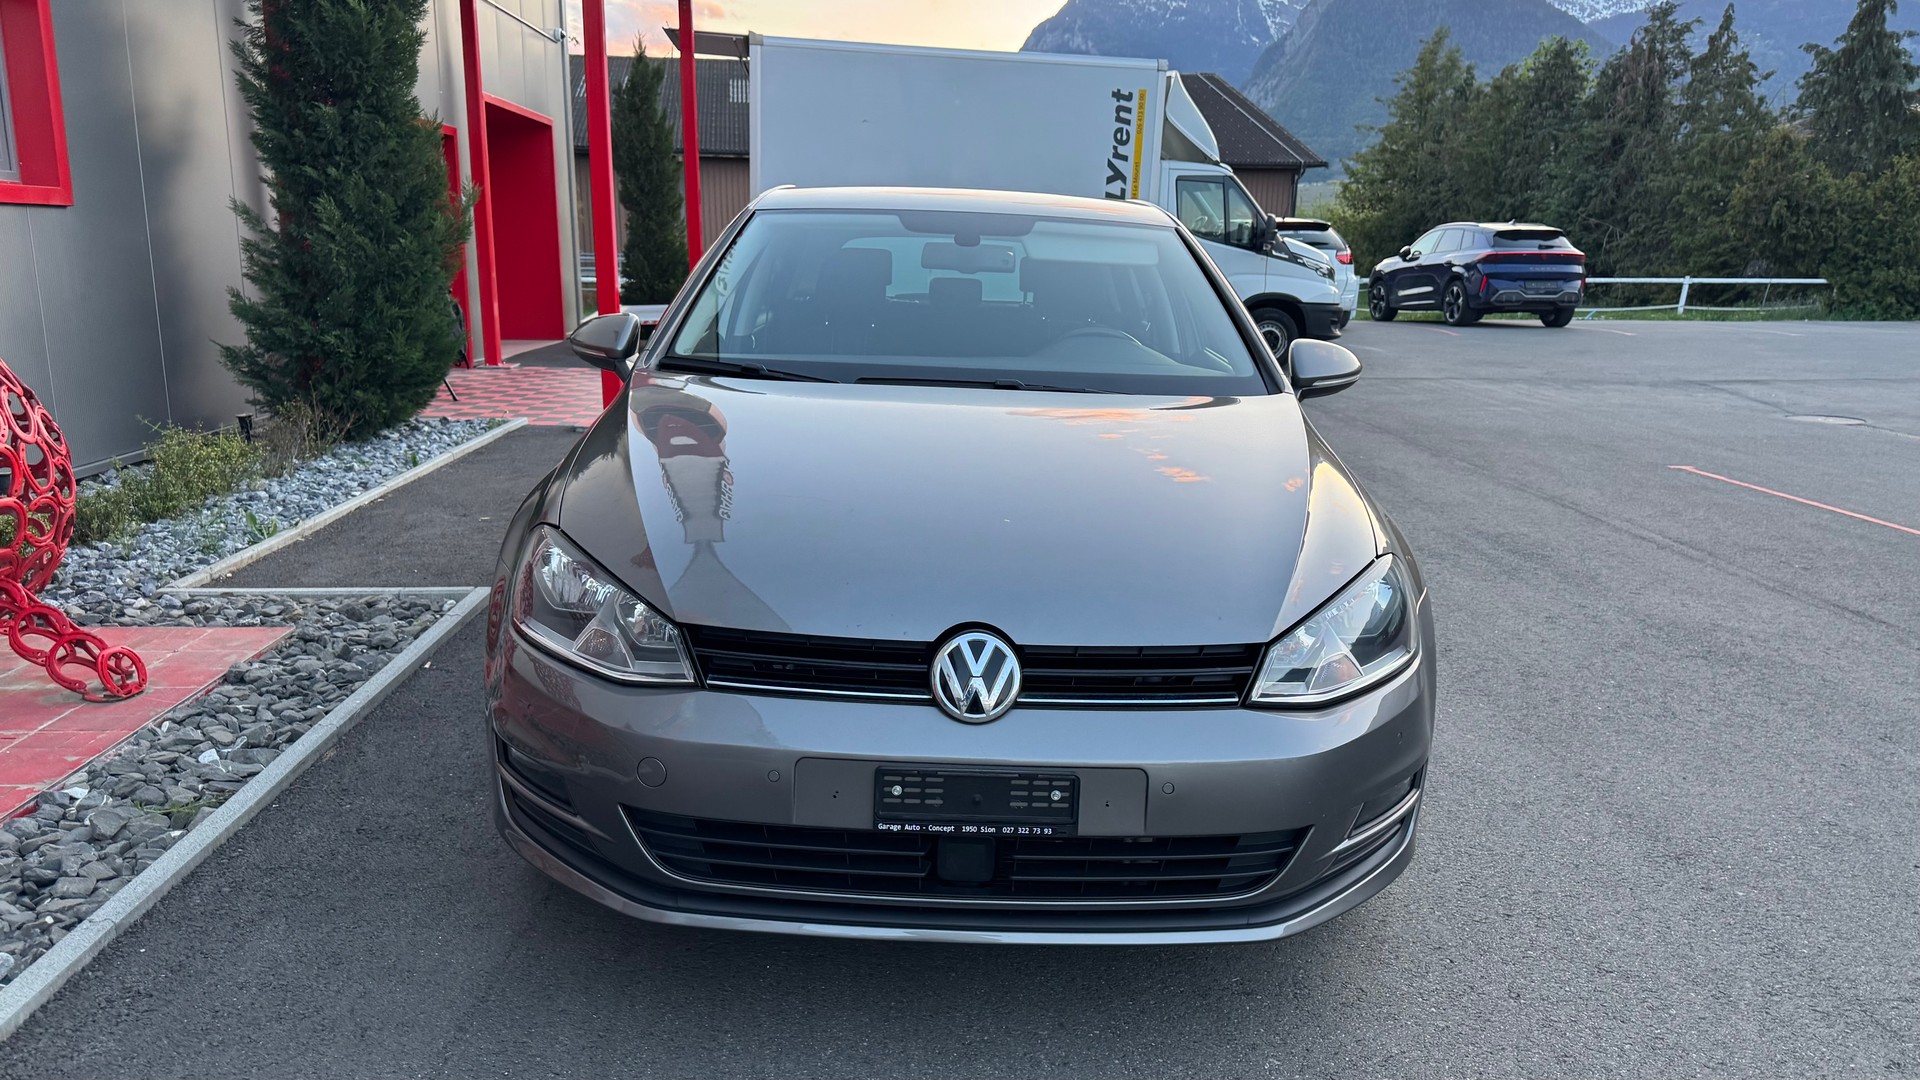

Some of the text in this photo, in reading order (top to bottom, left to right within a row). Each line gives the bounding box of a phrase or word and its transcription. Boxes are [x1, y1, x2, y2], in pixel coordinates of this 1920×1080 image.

[938, 636, 1015, 716] VW
[877, 823, 901, 831] Garage
[928, 824, 955, 833] Concept
[961, 825, 978, 833] 1950
[980, 825, 996, 833] Sion
[1002, 826, 1015, 834] 027
[1032, 827, 1041, 835] 73
[1043, 827, 1052, 835] 93
